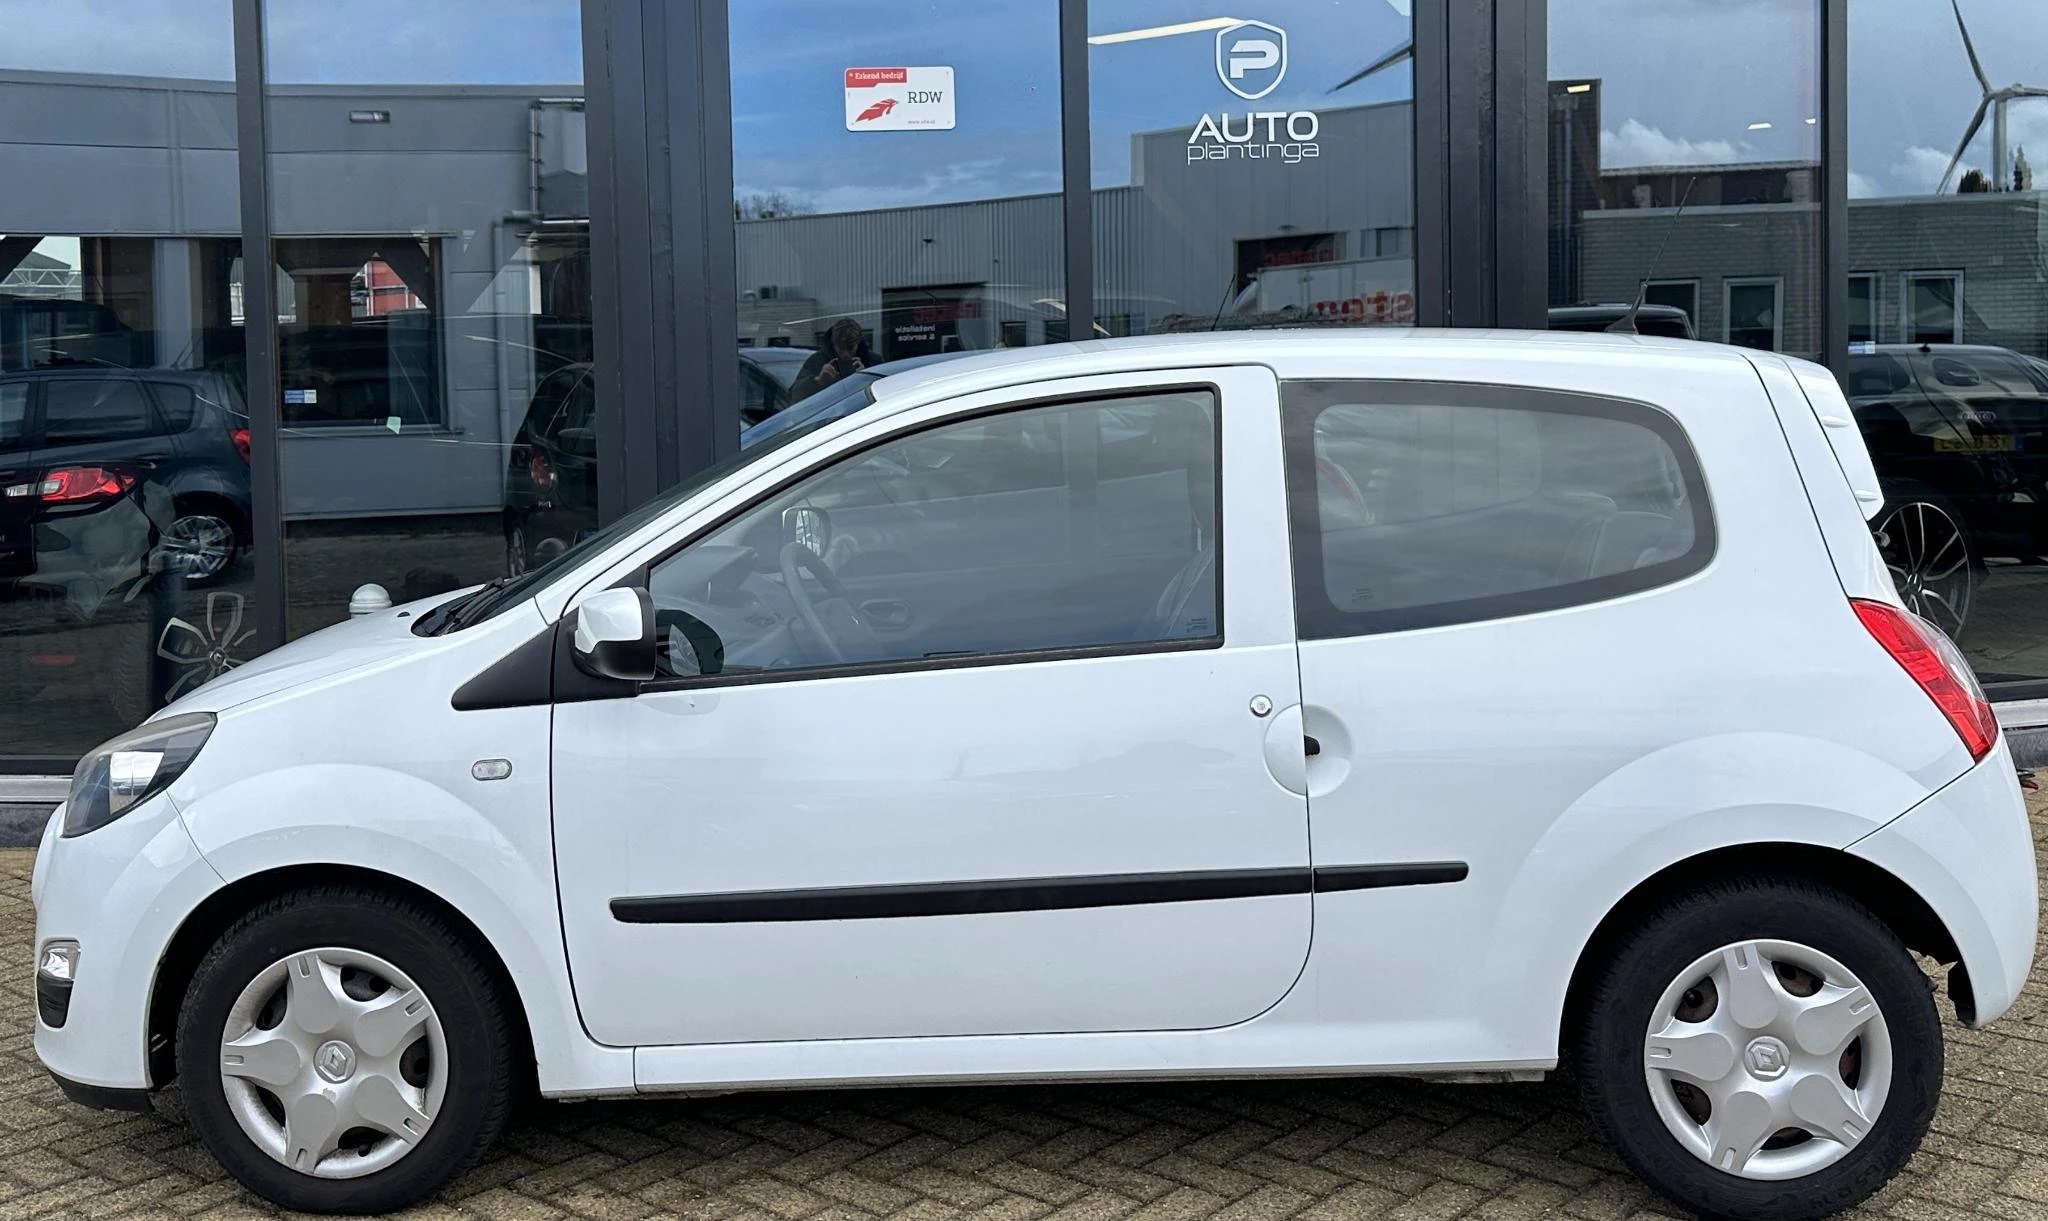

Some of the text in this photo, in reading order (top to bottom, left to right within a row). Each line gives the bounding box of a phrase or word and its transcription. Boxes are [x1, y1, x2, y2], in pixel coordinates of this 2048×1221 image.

[1230, 40, 1280, 79] P
[908, 91, 943, 104] RDW
[1188, 111, 1319, 144] AUTO
[1188, 142, 1320, 166] plantinga
